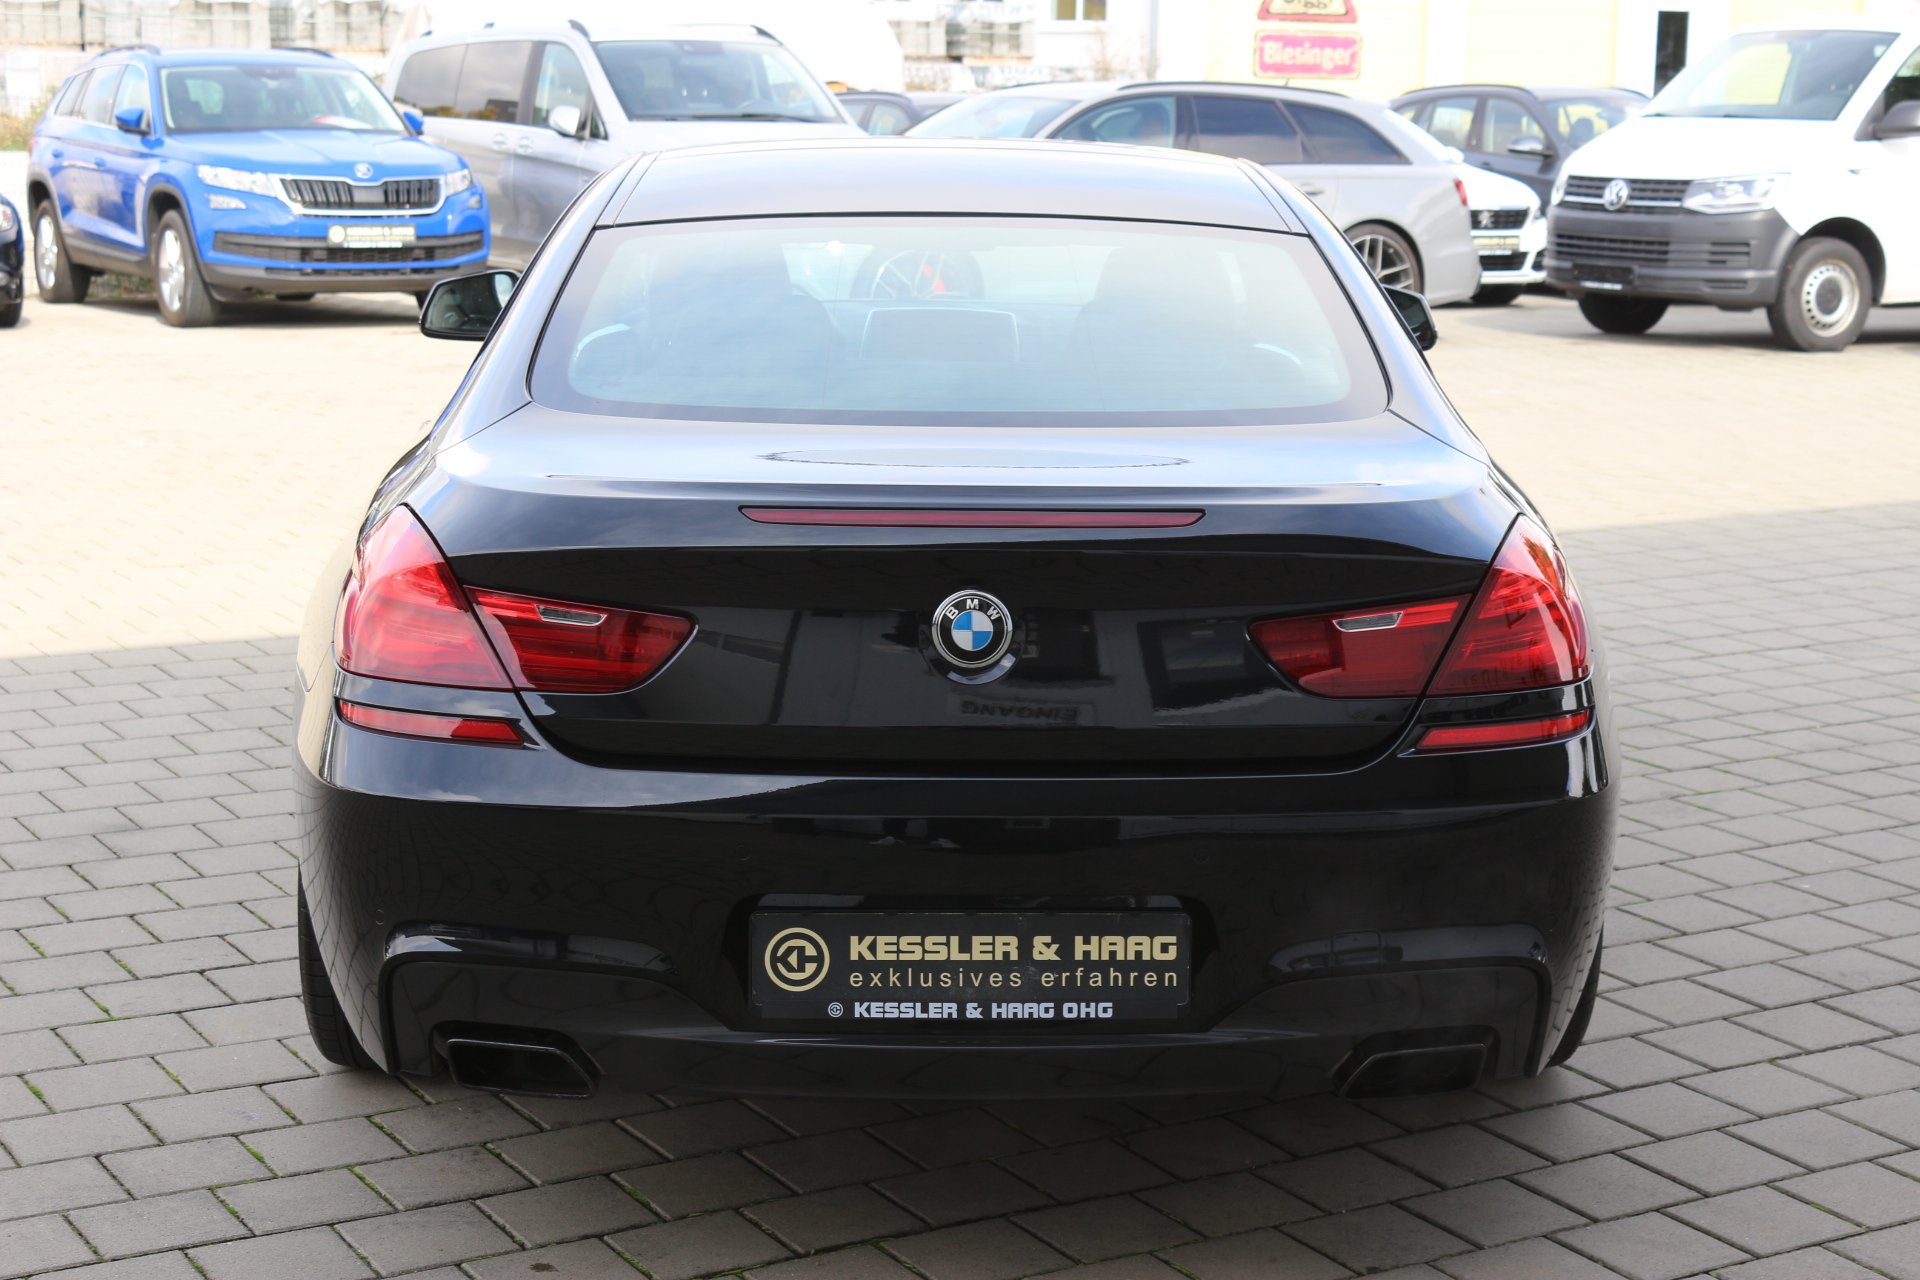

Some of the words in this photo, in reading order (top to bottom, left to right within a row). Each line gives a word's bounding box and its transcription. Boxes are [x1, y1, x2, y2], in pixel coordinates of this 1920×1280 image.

[945, 599, 1000, 620] BMW
[960, 701, 1079, 722] EINGANG
[850, 935, 1019, 960] KESSLER
[1032, 935, 1062, 960] &
[1075, 935, 1178, 960] HAAG
[850, 968, 1022, 987] exklusives
[1041, 968, 1178, 987] erfahren
[854, 1002, 958, 1019] KESSLER
[966, 1002, 984, 1019] &
[992, 1002, 1055, 1019] HAAG
[1063, 1002, 1113, 1019] OHG
